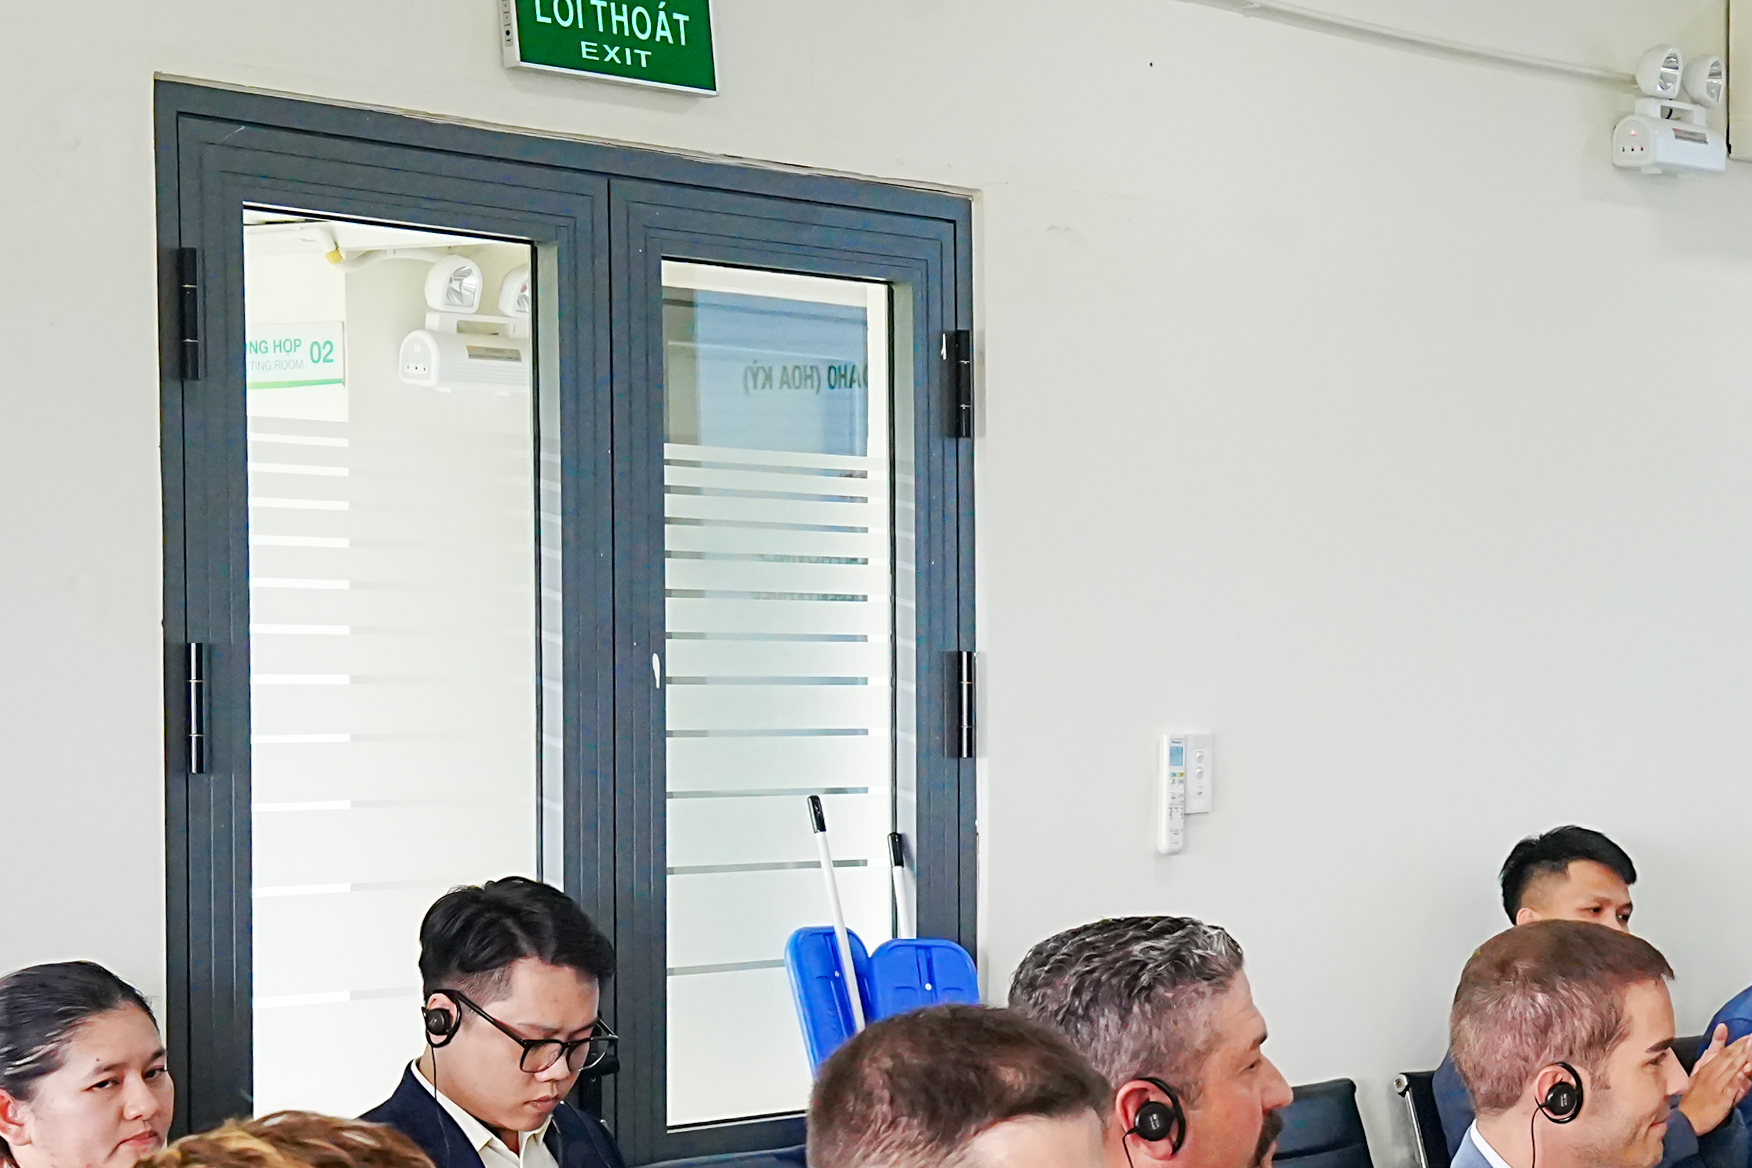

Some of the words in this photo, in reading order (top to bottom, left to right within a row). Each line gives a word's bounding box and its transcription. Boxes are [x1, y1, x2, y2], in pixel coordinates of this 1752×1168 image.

[591, 0, 690, 46] THOÁT
[580, 41, 651, 67] EXIT
[247, 340, 269, 354] NG
[273, 338, 302, 356] HỌP
[309, 340, 334, 364] 02
[248, 360, 272, 371] TING
[275, 359, 304, 370] ROOM
